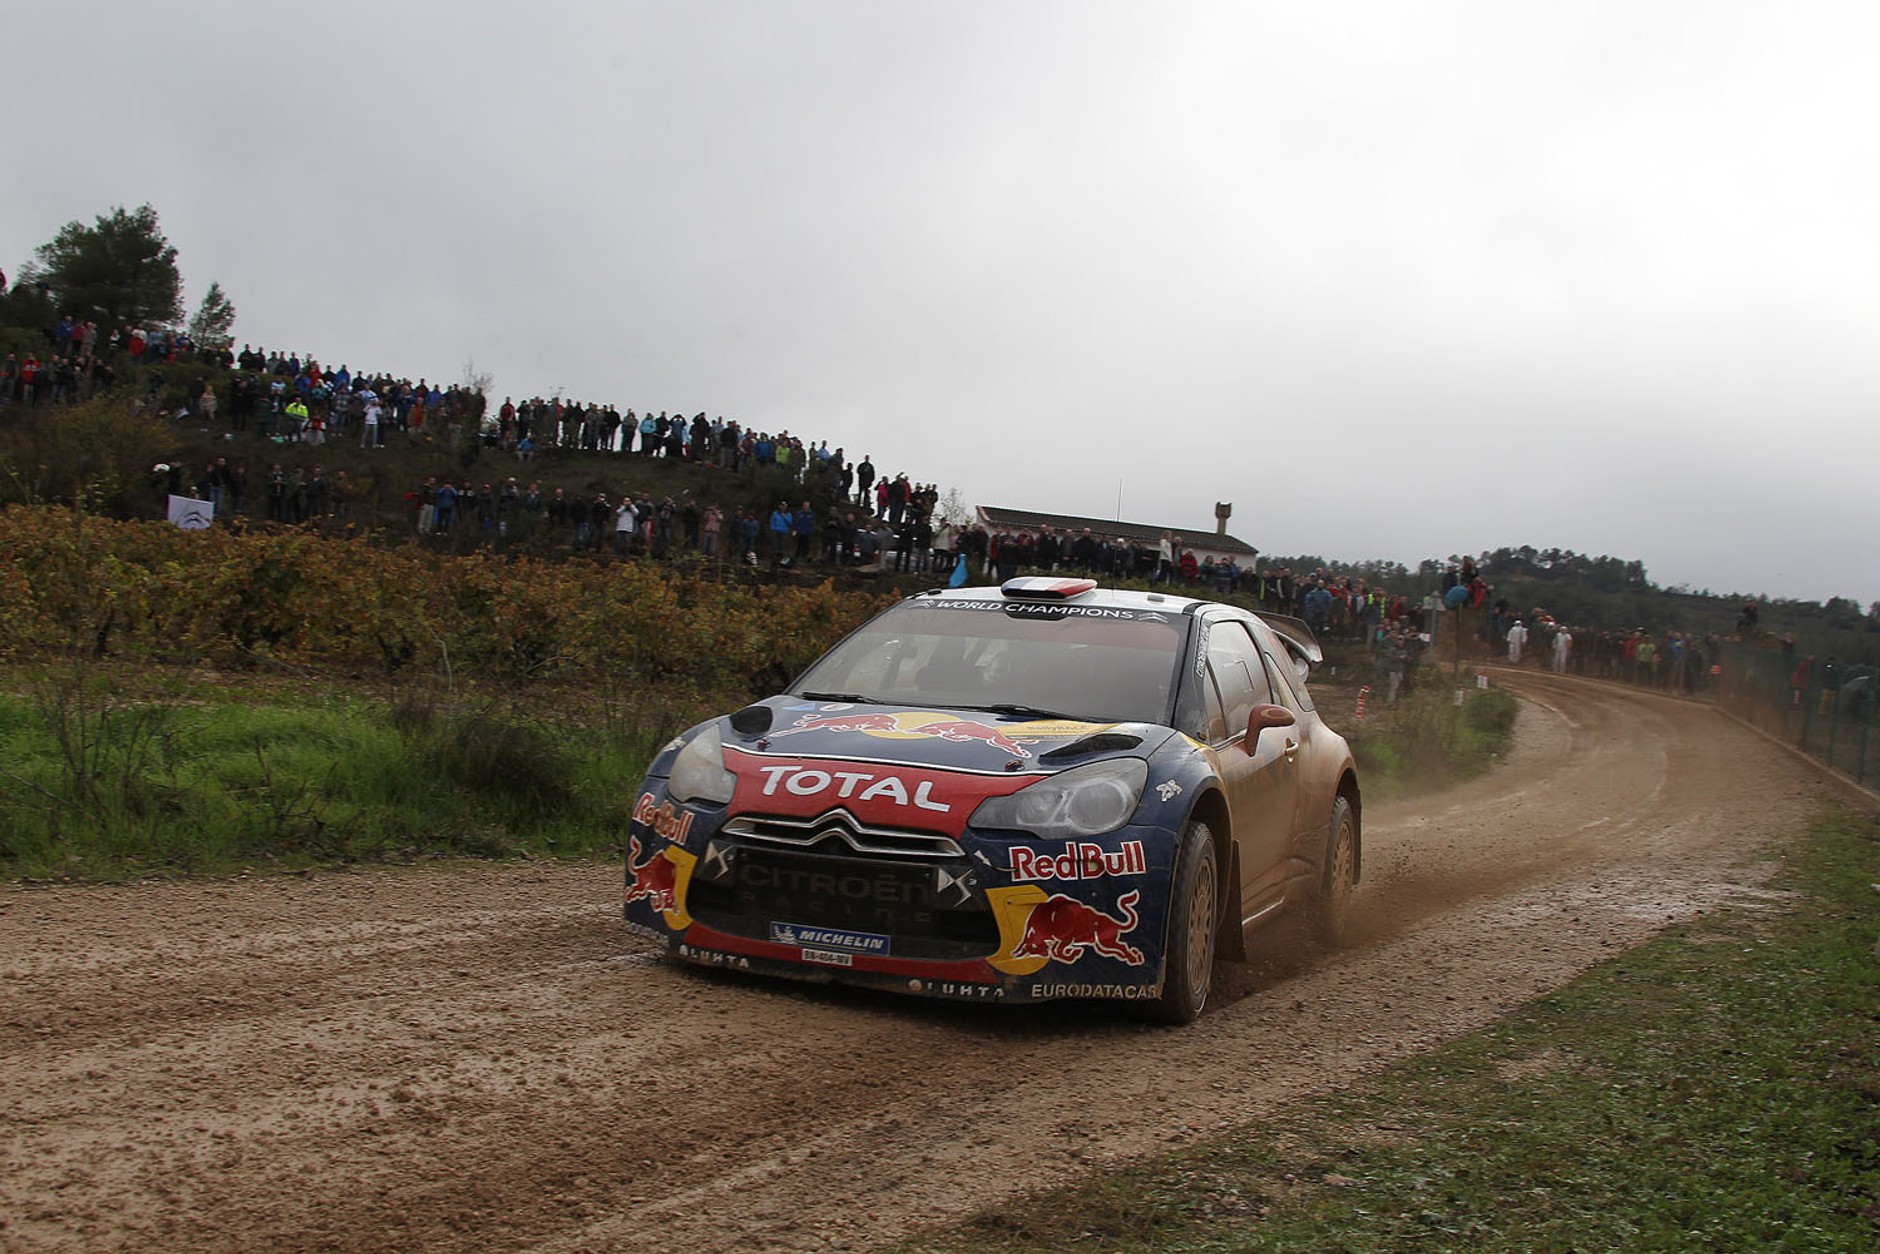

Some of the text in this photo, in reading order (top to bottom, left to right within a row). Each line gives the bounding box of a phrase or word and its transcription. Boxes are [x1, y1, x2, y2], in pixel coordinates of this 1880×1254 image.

[937, 600, 1134, 619] WORLD CHAMPIONS
[760, 766, 951, 812] TOTAL
[799, 930, 884, 949] MICHELIN
